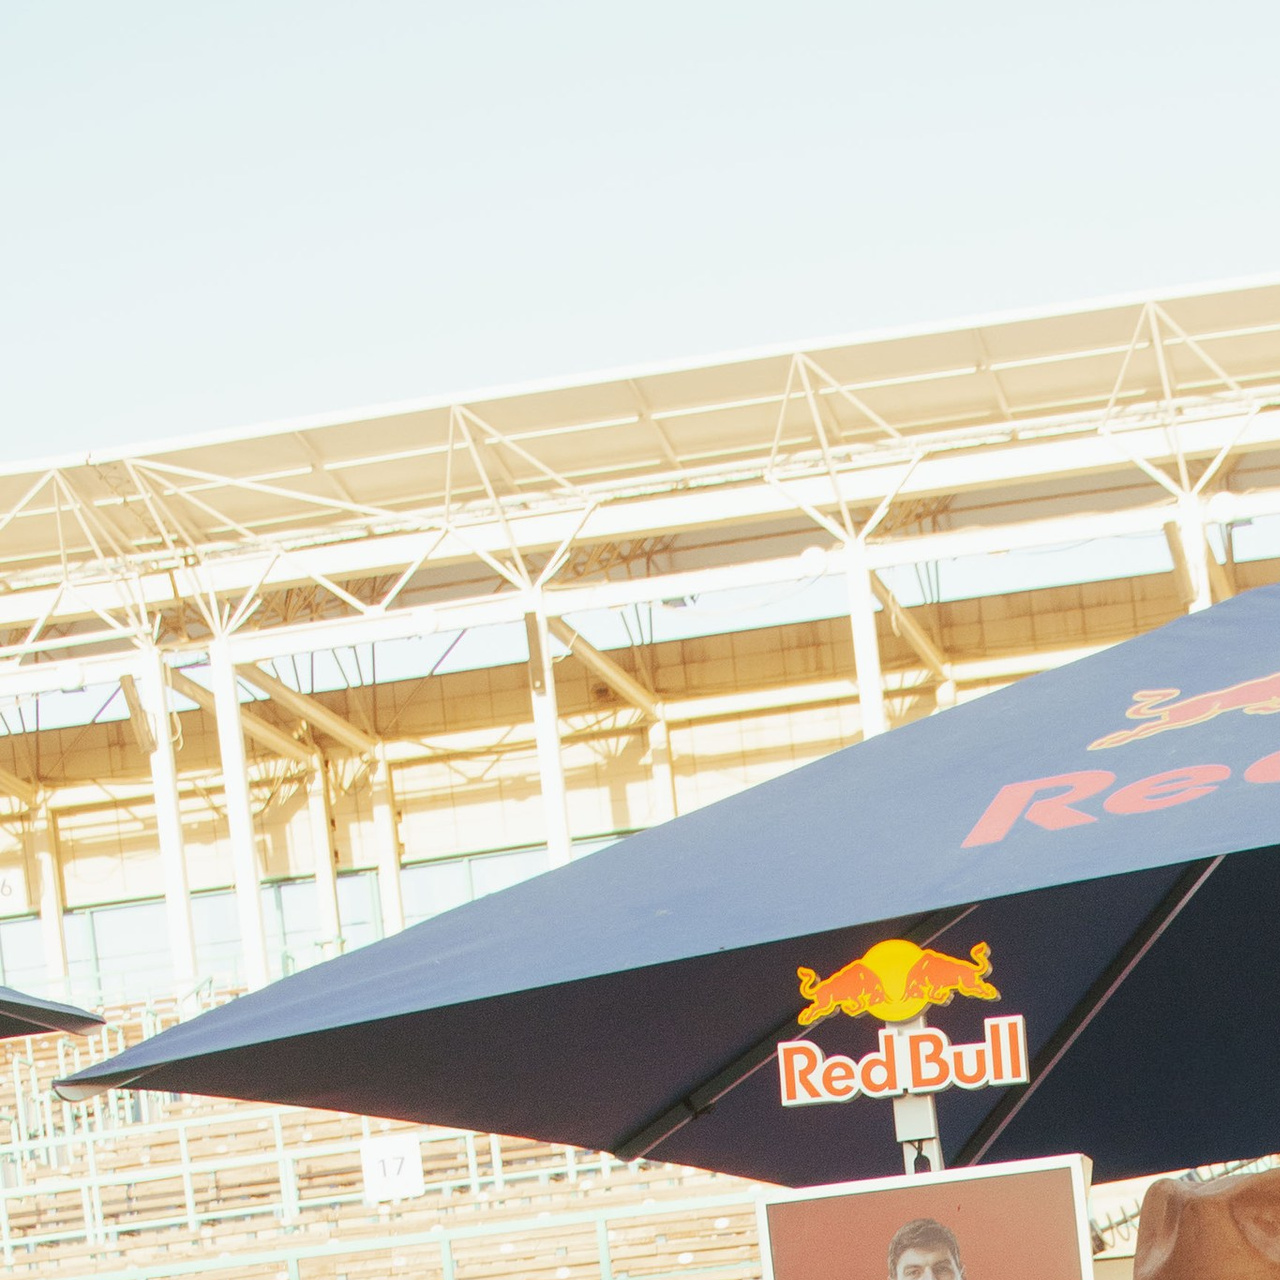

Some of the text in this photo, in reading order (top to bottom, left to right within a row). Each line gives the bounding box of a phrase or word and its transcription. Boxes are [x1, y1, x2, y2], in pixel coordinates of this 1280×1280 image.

[782, 1021, 1023, 1101] Red Bull
[380, 1156, 405, 1178] 17
